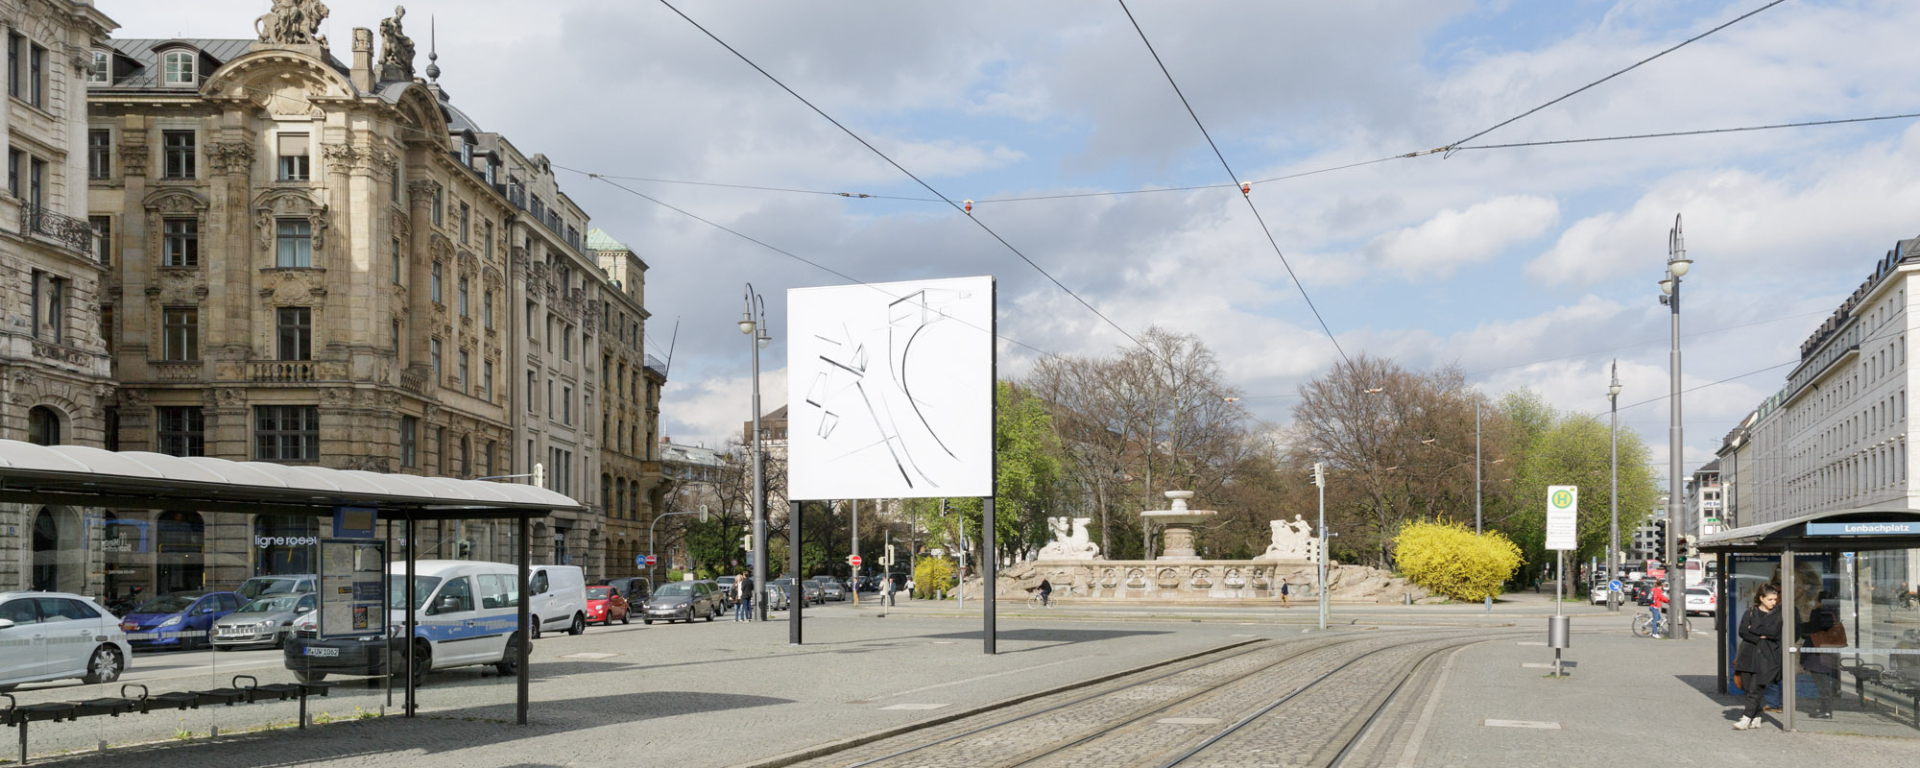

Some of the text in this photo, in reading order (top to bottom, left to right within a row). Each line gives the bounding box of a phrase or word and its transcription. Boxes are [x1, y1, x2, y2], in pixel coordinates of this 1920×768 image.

[1557, 494, 1567, 504] H
[1845, 524, 1910, 533] Lenbachplatz
[255, 534, 284, 548] ligne
